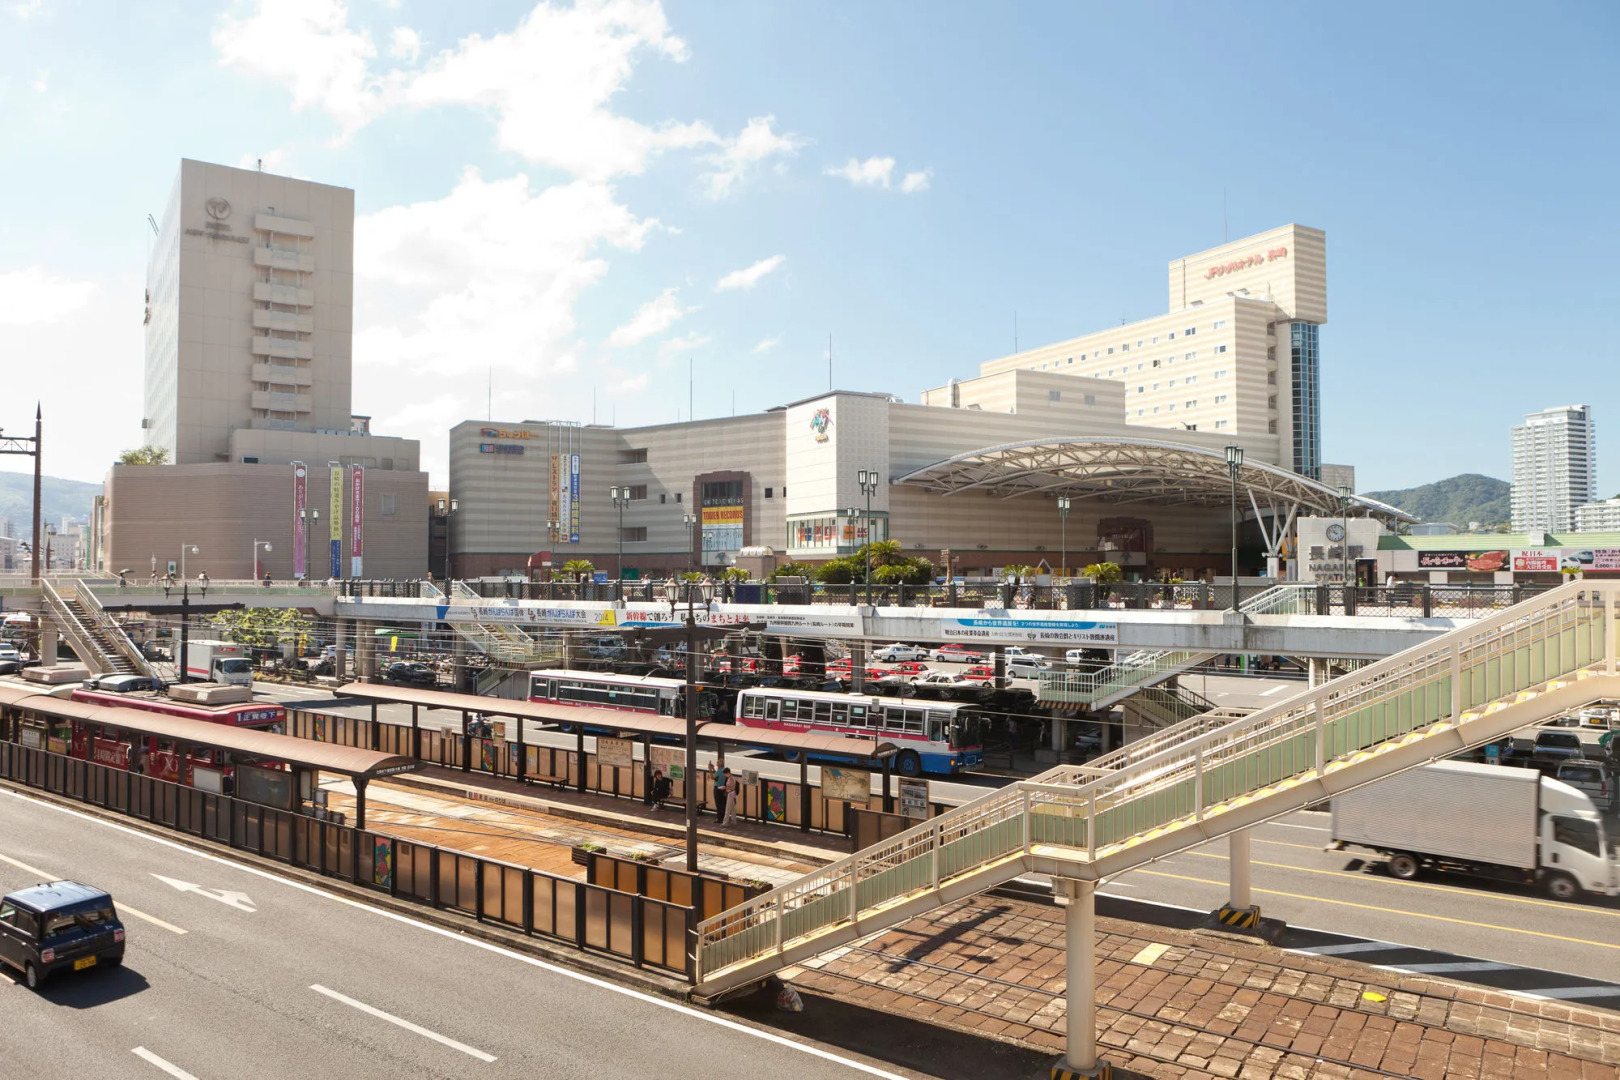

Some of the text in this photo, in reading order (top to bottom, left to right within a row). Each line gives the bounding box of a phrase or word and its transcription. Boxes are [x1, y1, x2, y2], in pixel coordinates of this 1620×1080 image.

[703, 510, 743, 520] TOWER RECORDS
[594, 612, 609, 622] 2014
